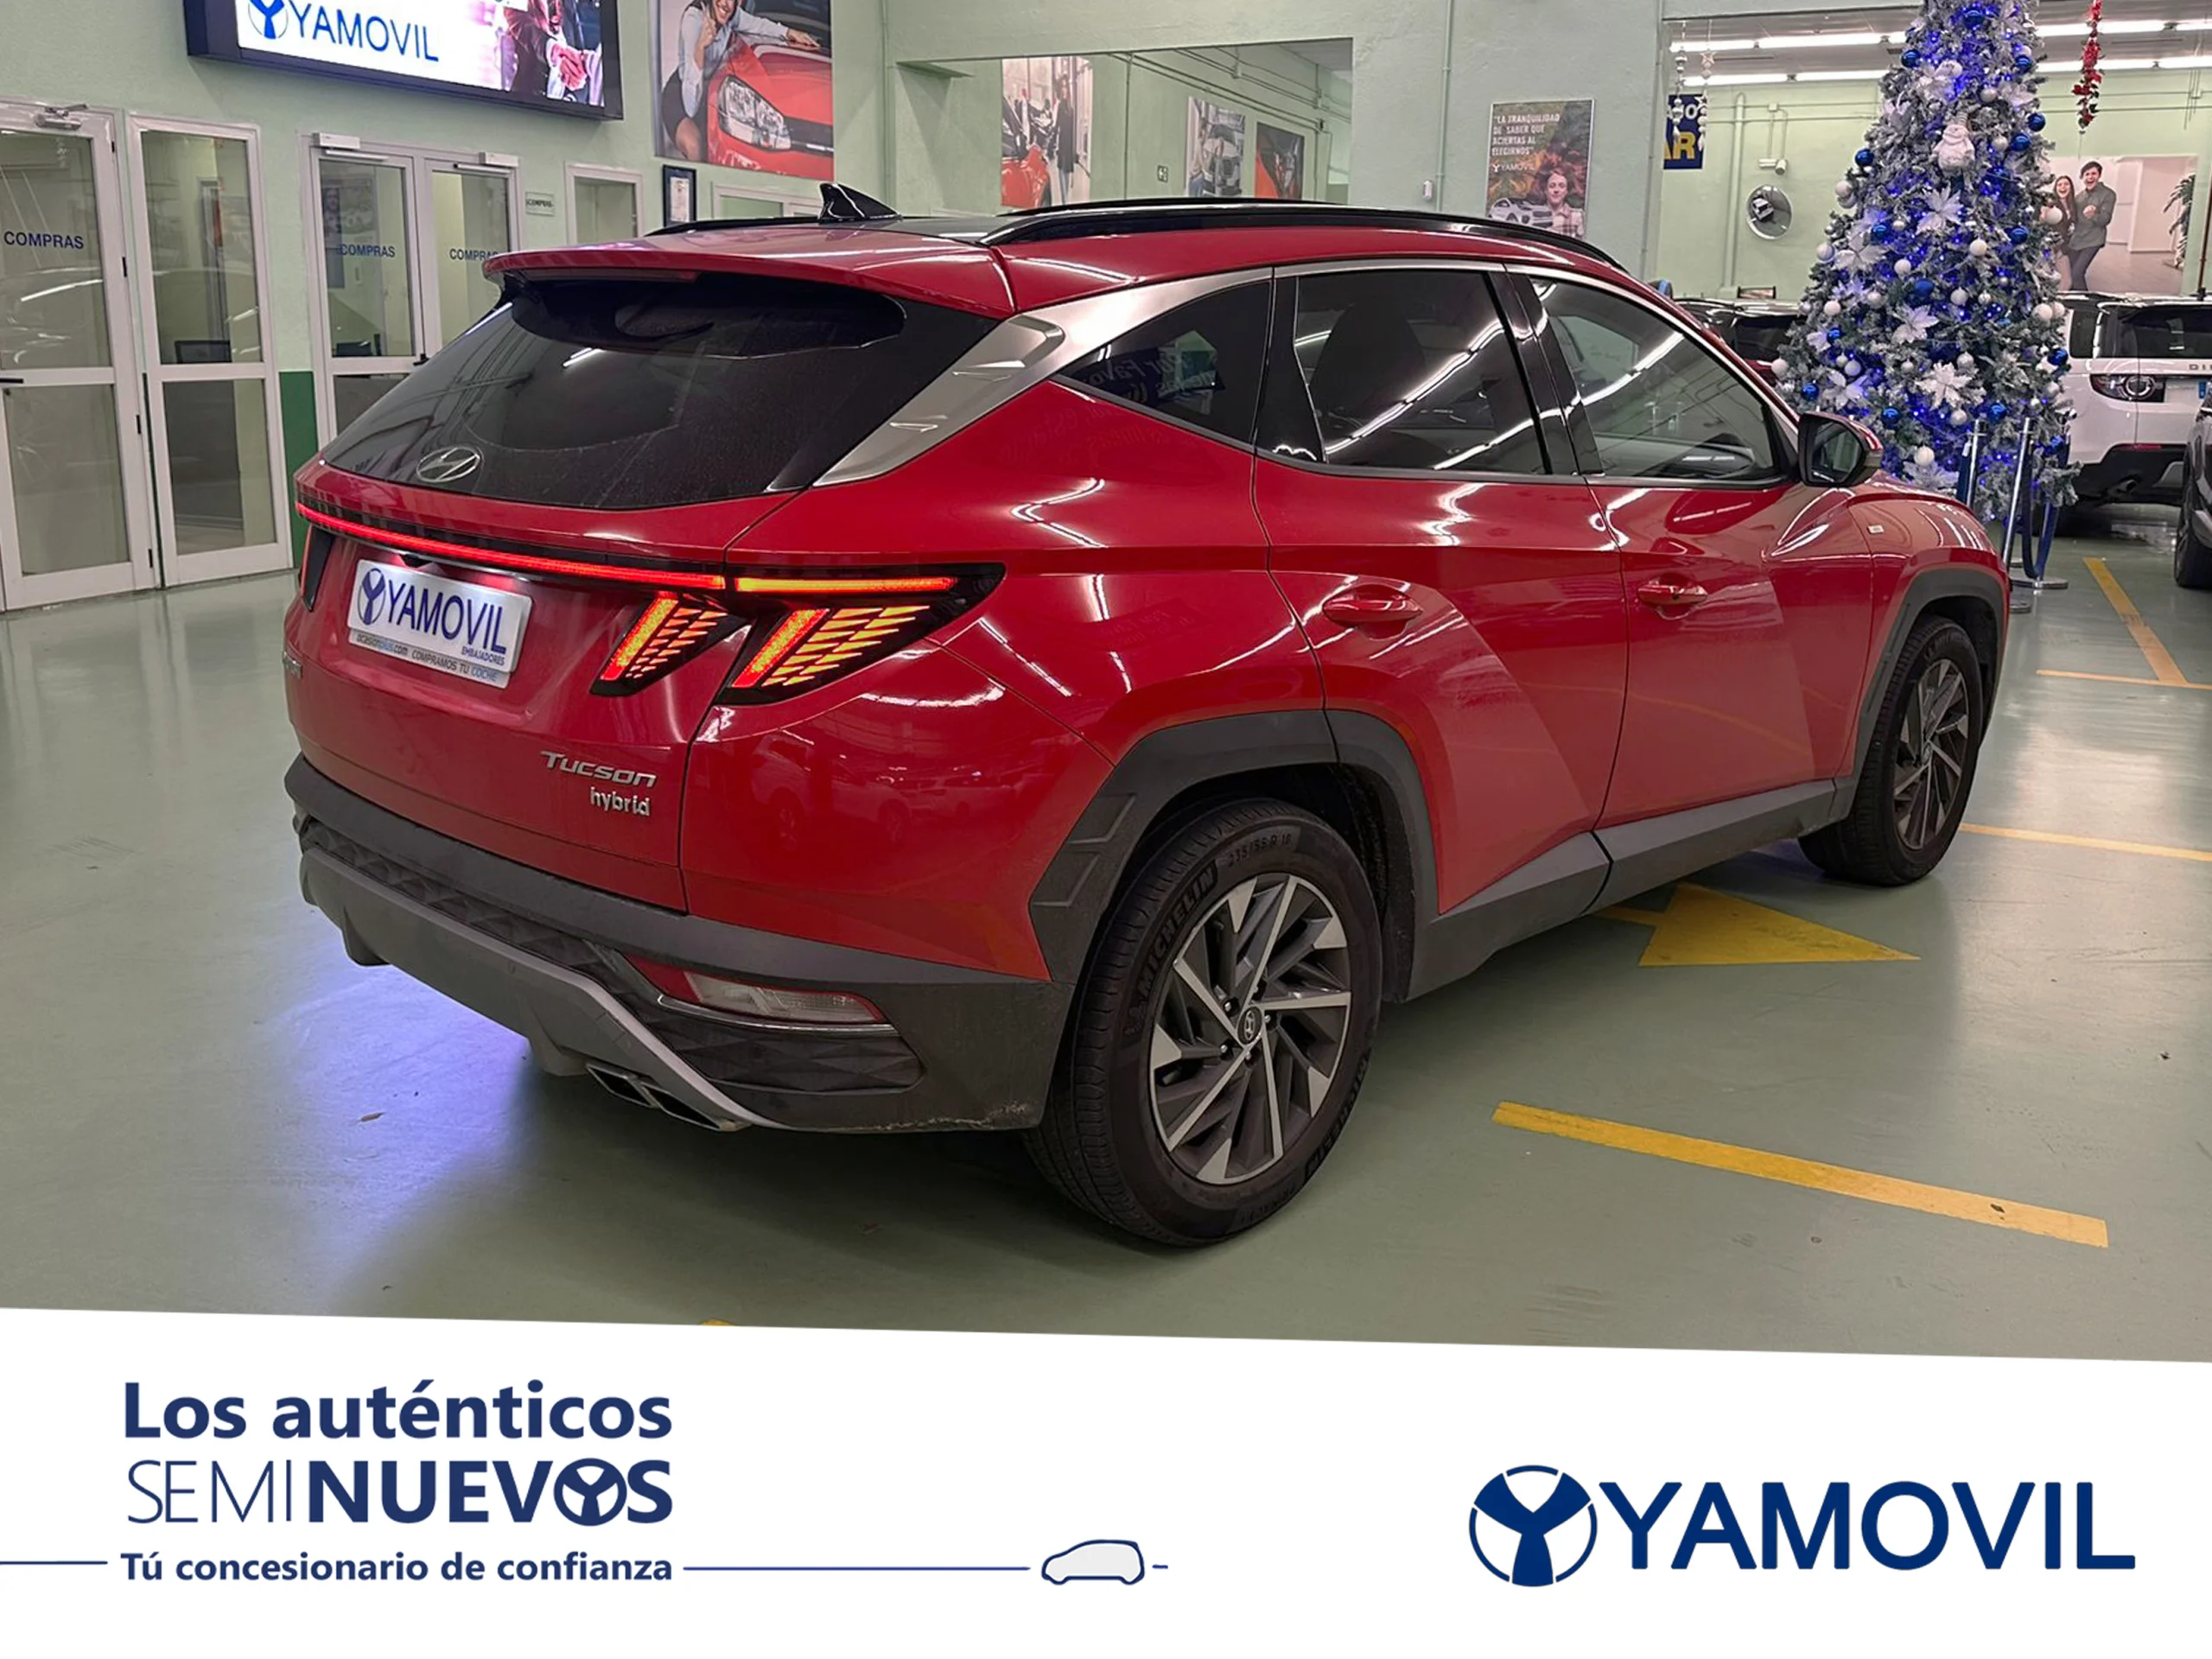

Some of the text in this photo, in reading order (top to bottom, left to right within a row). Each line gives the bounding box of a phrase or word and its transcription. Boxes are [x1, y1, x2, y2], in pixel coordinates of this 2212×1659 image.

[288, 0, 439, 61] YAMOVIL
[1507, 114, 1560, 123] TRANQUILIDAD
[1506, 125, 1529, 134] SABER
[1530, 124, 1546, 133] QUE
[1492, 137, 1526, 145] ACIERTAS
[3, 231, 85, 250] COMPRAS
[340, 244, 396, 258] COMPRAS
[388, 578, 507, 655] YAMOVIL
[412, 650, 458, 671] COMPRAMOS
[459, 663, 471, 675] TU
[461, 645, 505, 666] EMBAJADORES
[590, 785, 651, 817] hybrid
